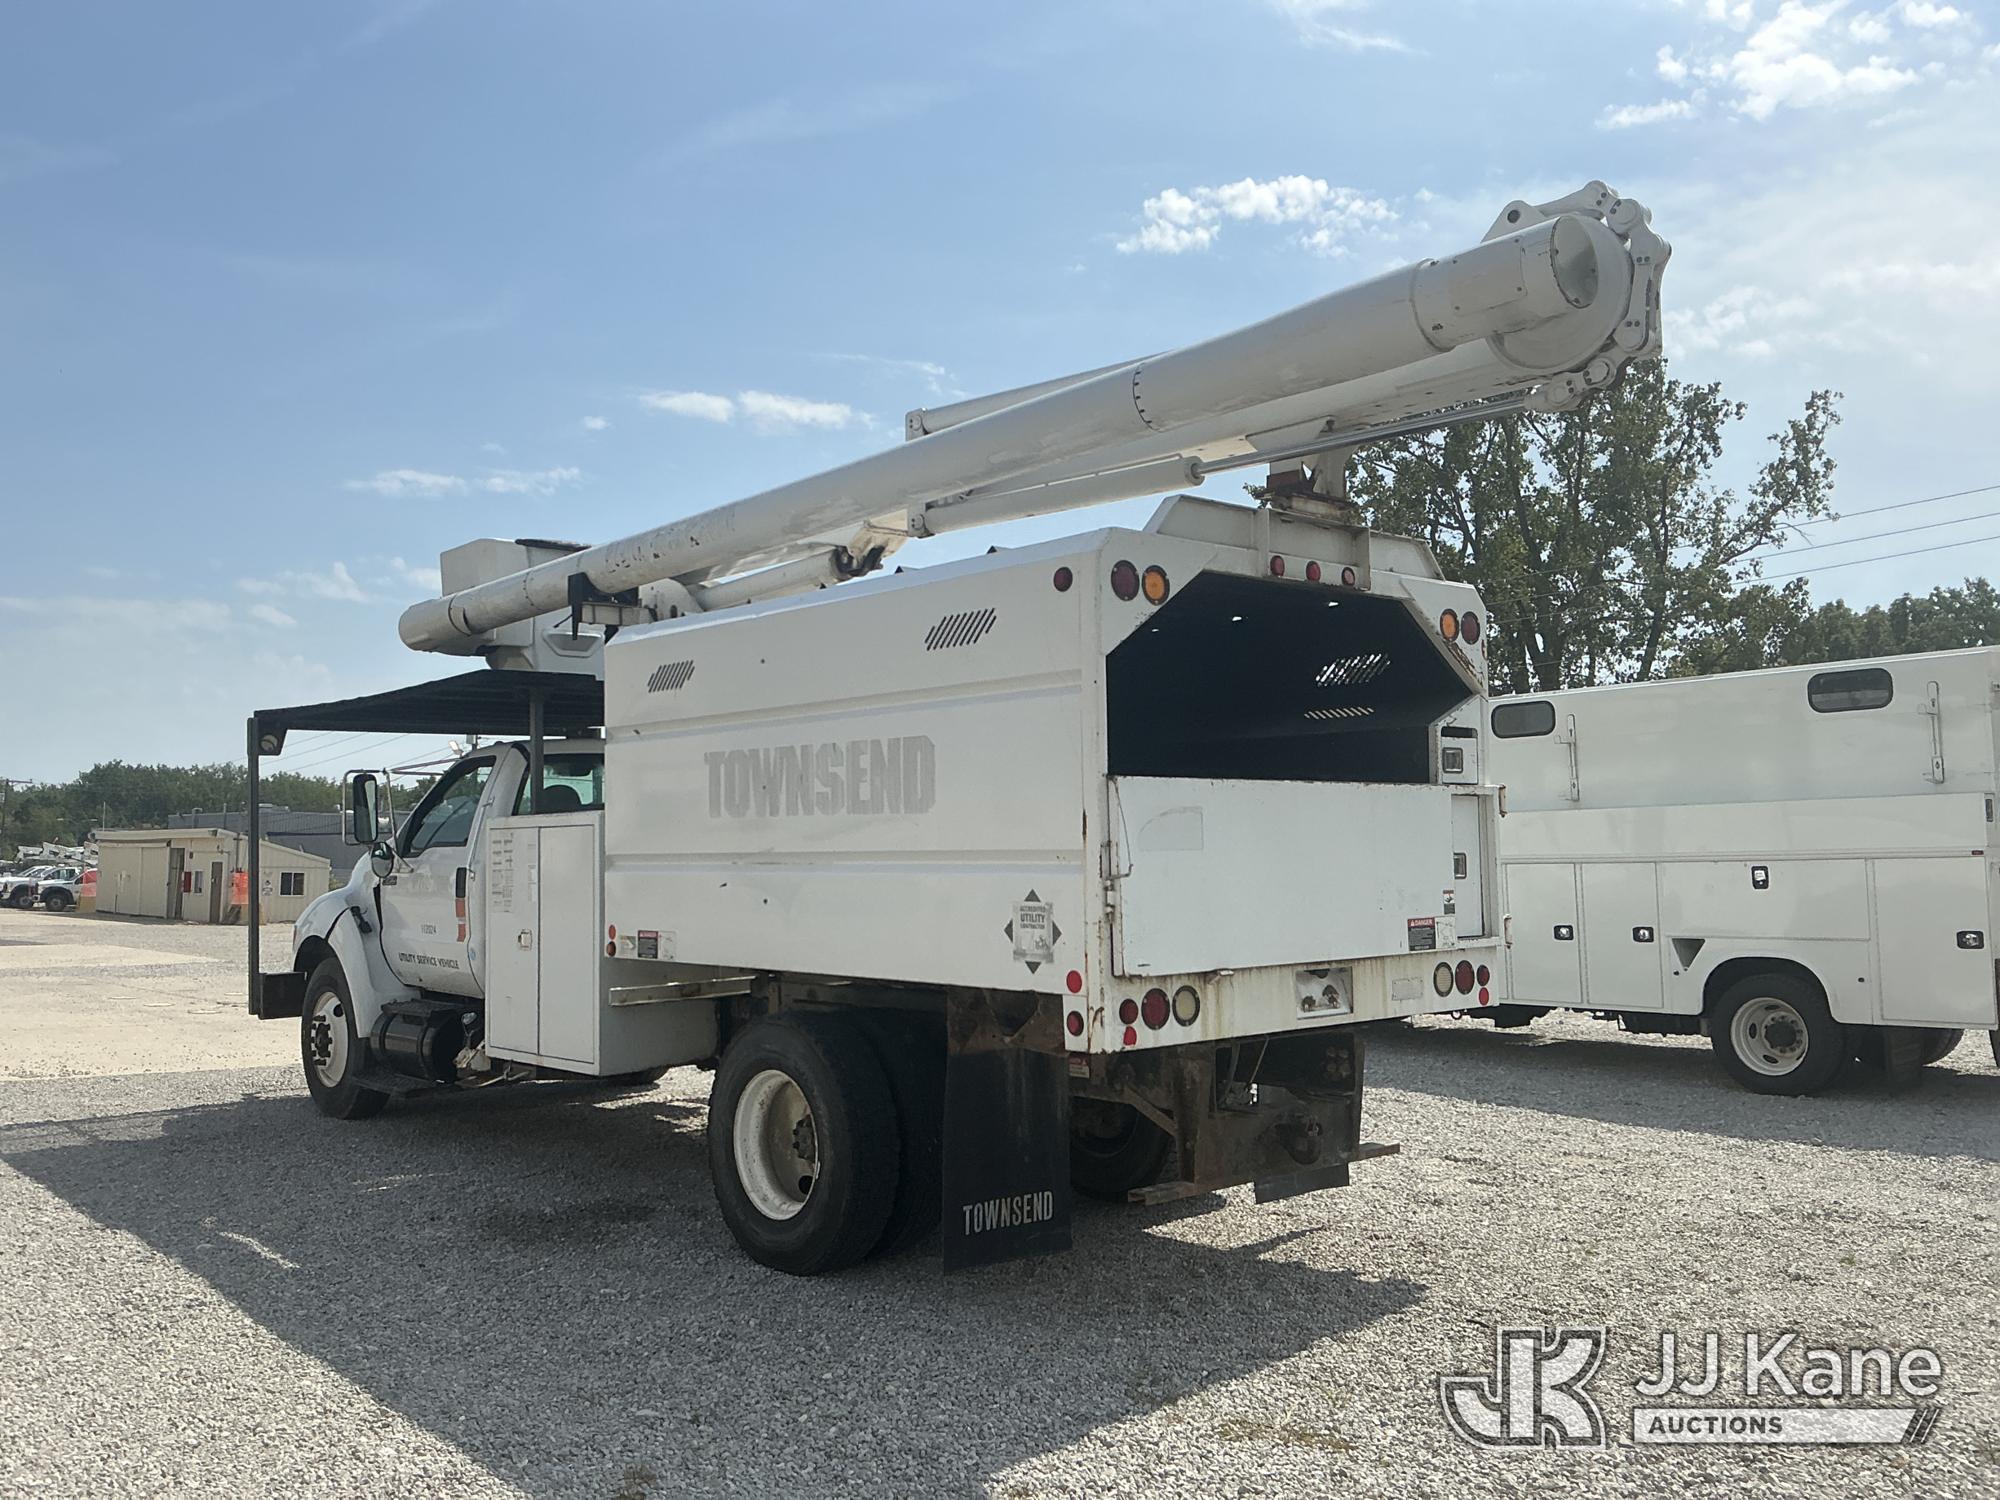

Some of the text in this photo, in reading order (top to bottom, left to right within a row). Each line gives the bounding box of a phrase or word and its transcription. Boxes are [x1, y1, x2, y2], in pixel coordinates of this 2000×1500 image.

[704, 735, 936, 819] TOWNSEND
[1020, 913, 1045, 923] UTILITY
[399, 952, 460, 970] UTILITY SERVICE VEHICLE
[963, 1190, 1053, 1235] TOWNSEND
